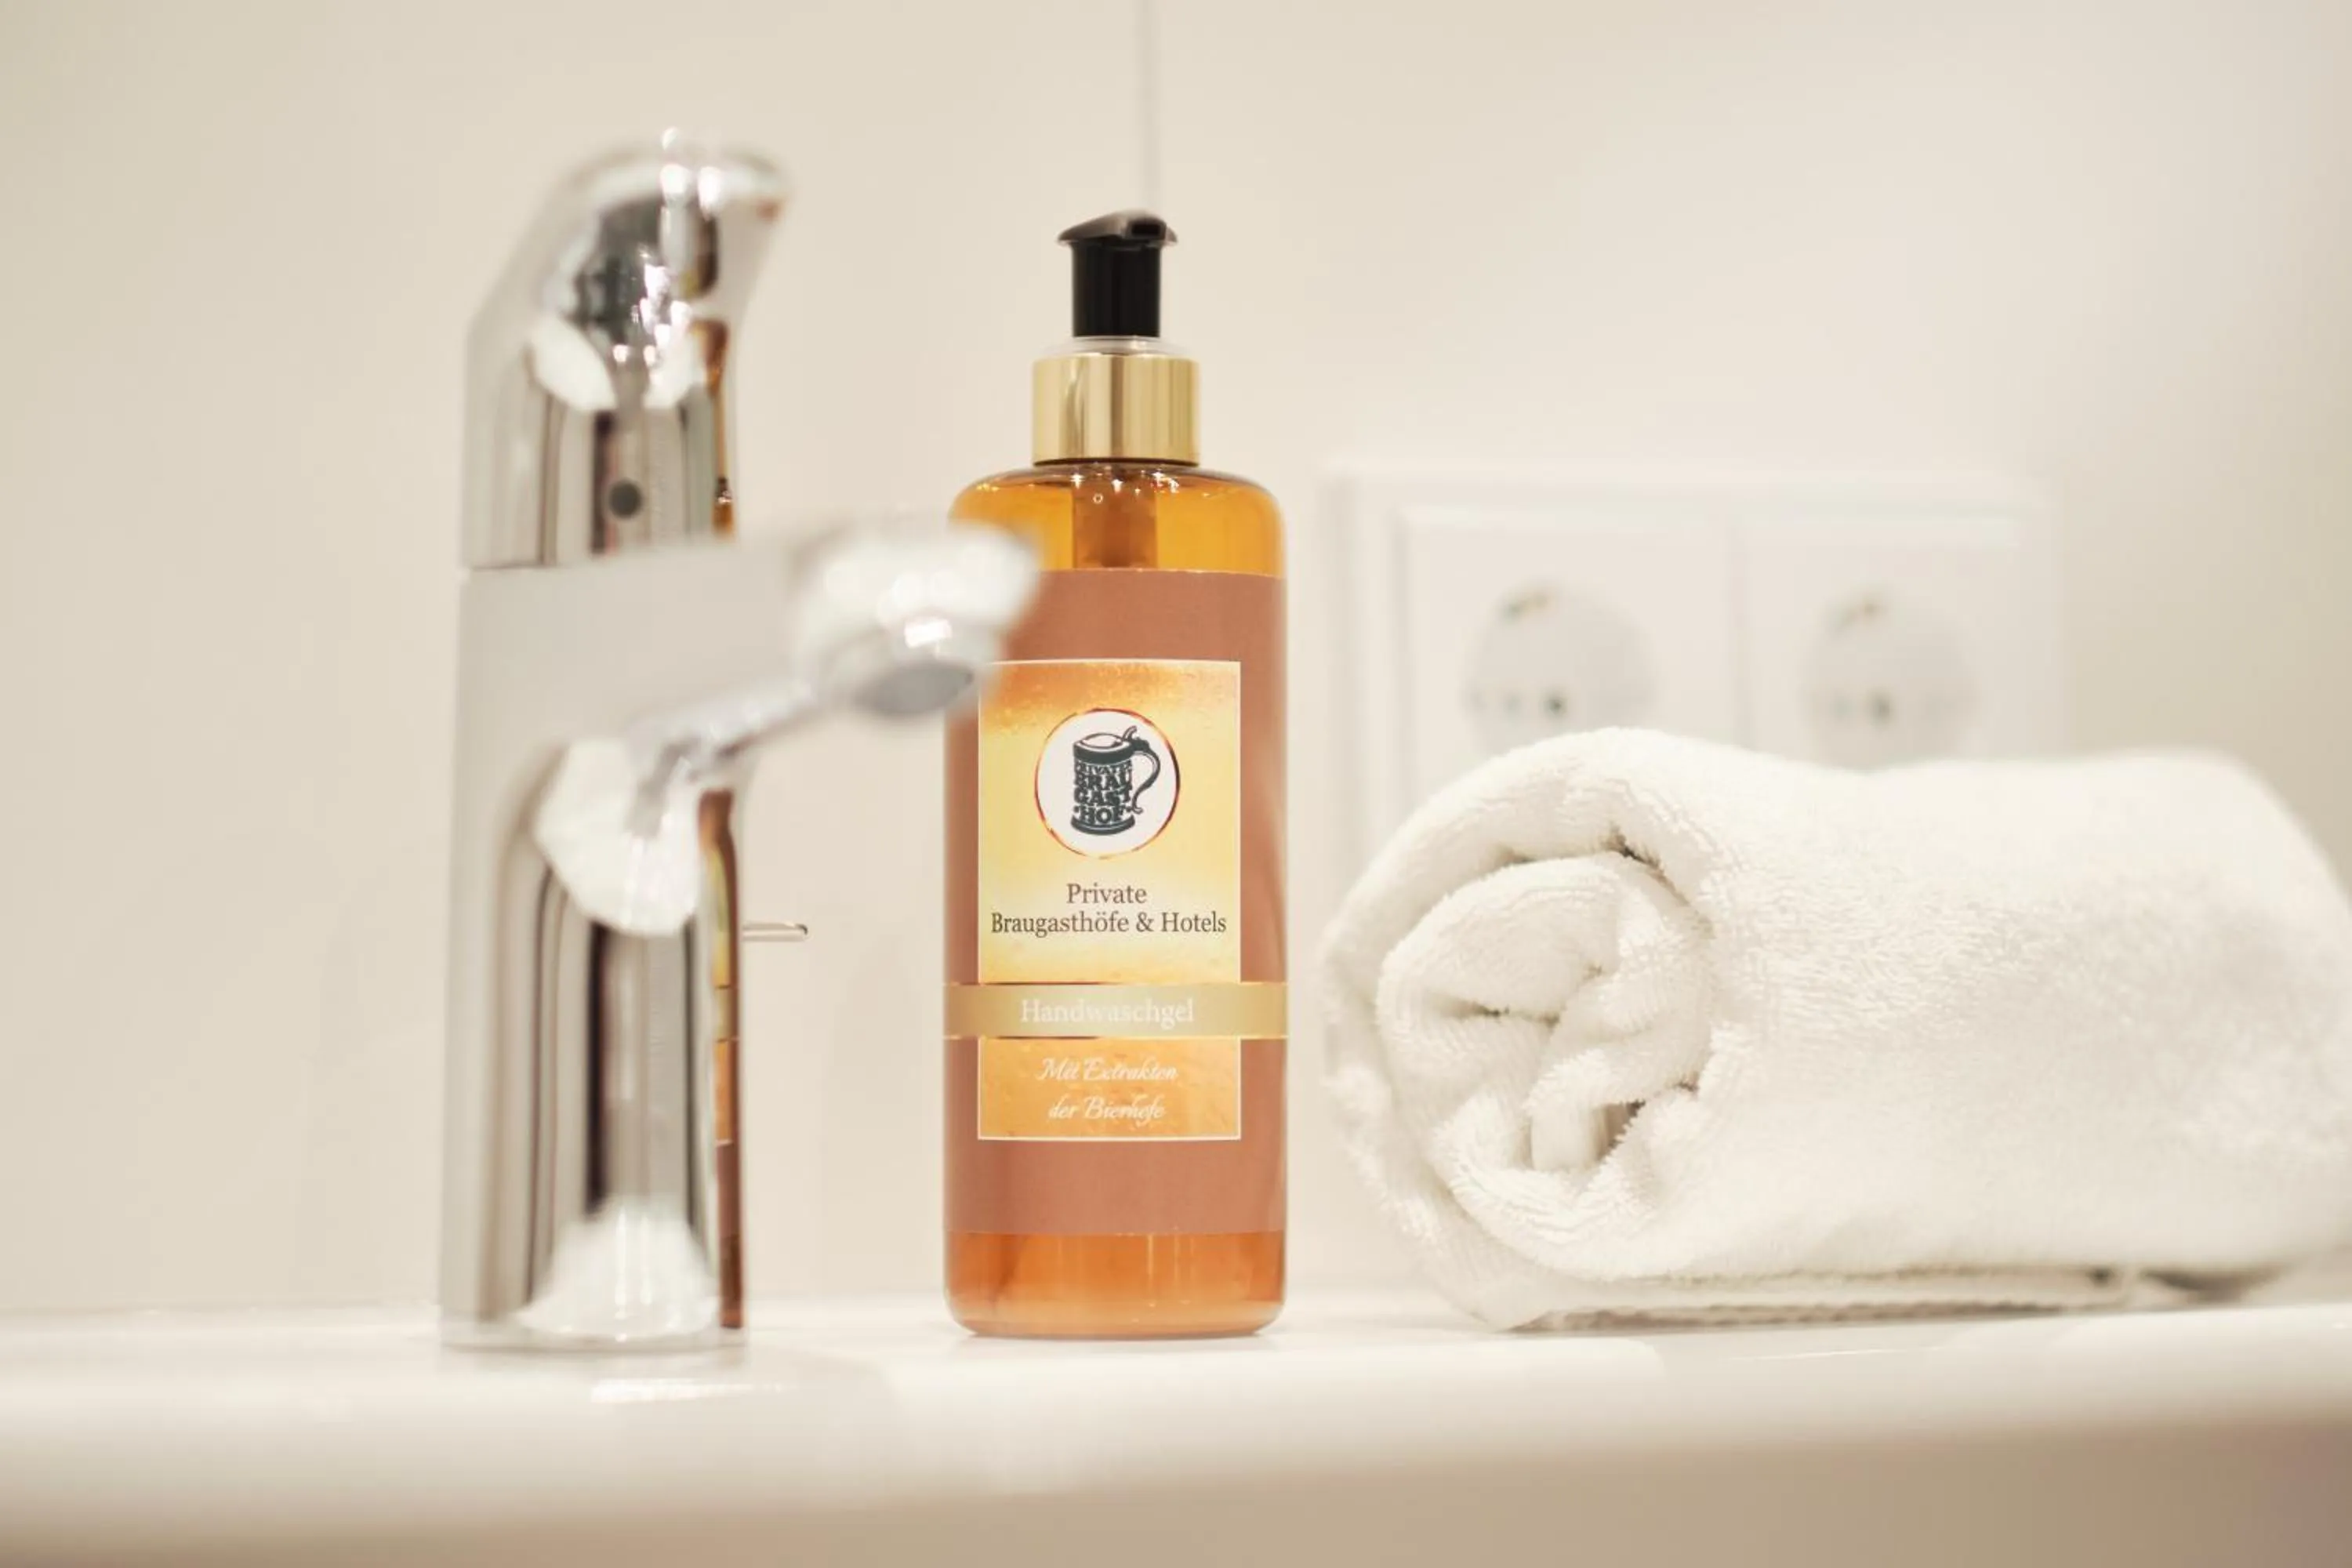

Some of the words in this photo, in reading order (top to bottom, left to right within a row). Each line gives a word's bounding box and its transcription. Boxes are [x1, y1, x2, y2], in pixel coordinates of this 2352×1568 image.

[1074, 772, 1132, 790] BRAU
[1074, 786, 1131, 805] GAST
[1080, 804, 1126, 824] HOF
[1066, 883, 1148, 904] Private
[991, 911, 1130, 938] Braugasthöfe
[1135, 912, 1155, 933] &
[1161, 910, 1227, 933] Hotels
[1021, 997, 1196, 1030] Handwaschgel
[1036, 1057, 1080, 1081] Mit
[1083, 1055, 1178, 1081] Extrakten
[1047, 1092, 1080, 1120] der
[1083, 1093, 1166, 1127] Bierhefe
